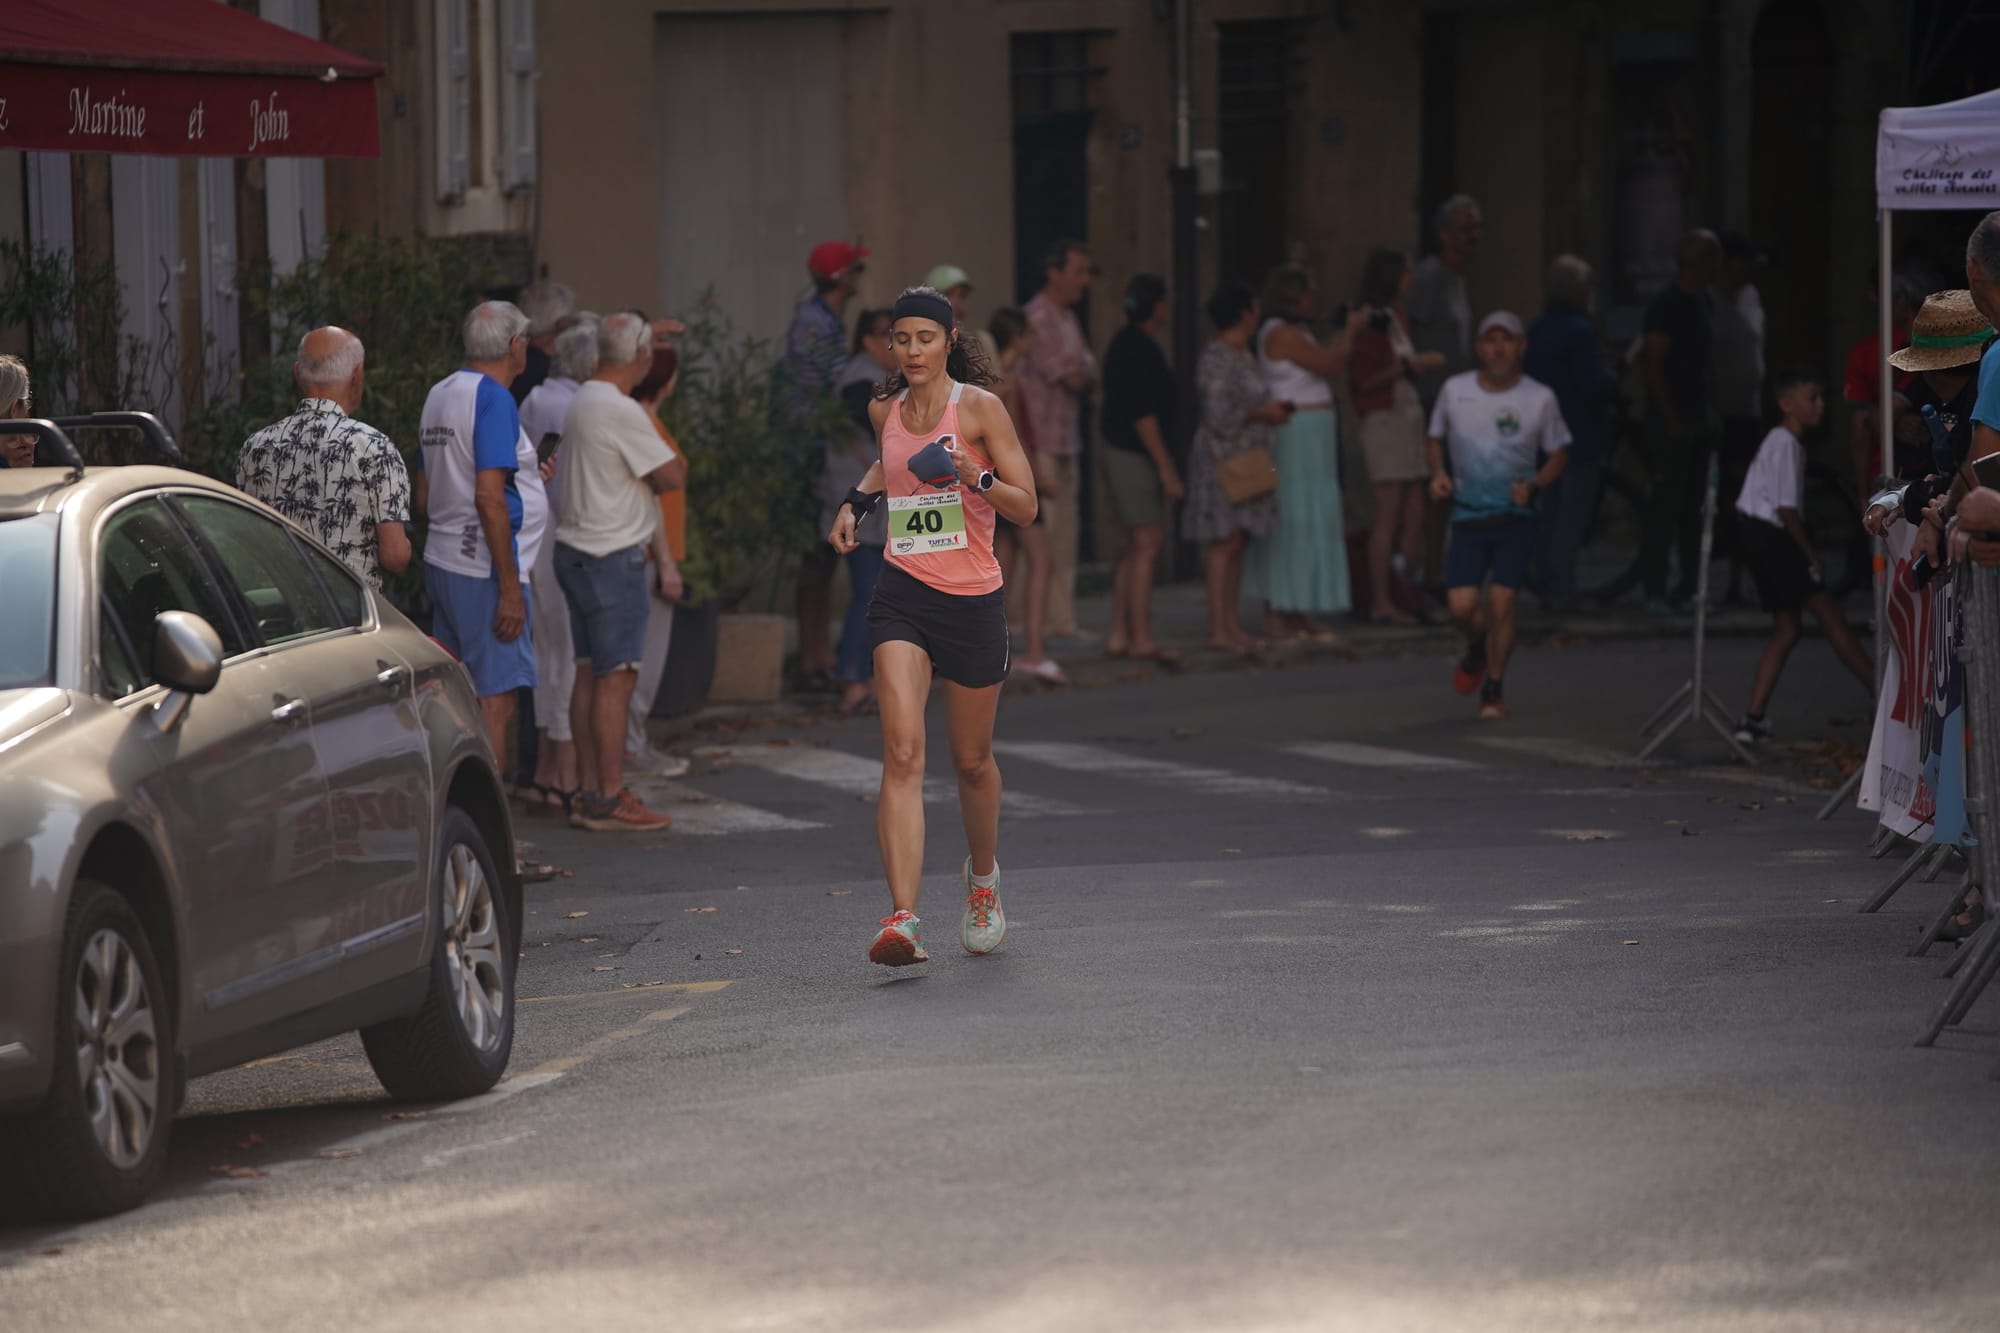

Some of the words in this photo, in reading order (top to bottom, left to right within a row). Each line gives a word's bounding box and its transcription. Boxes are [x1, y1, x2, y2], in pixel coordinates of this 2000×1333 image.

[68, 88, 146, 138] Martine
[187, 99, 206, 140] et
[248, 90, 291, 152] John
[1902, 168, 1965, 182] Challenge
[1971, 167, 1993, 180] des
[906, 509, 943, 534] 40
